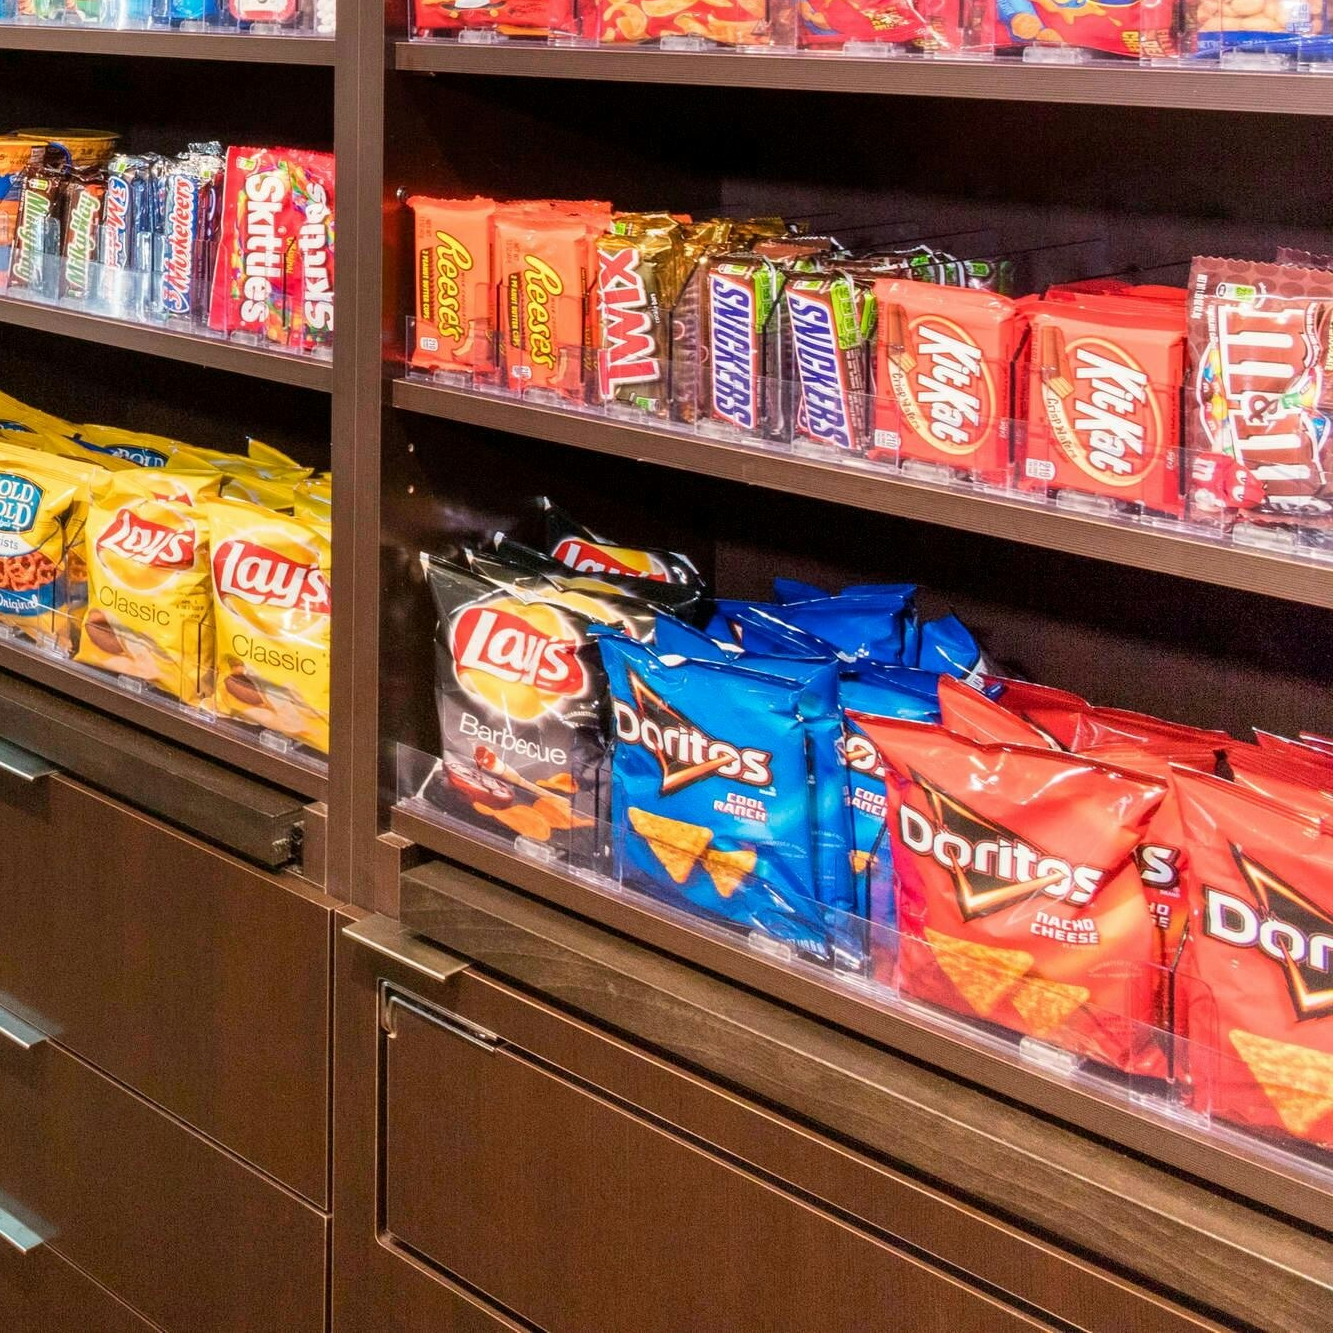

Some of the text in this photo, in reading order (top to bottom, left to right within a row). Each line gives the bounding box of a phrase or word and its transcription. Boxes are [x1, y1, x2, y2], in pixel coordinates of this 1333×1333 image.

[111, 180, 126, 200] 3
[66, 190, 100, 287] Milky Way
[164, 176, 195, 311] 3 Musketeers
[241, 174, 285, 323] Skittles
[298, 183, 335, 331] Skittles
[422, 280, 430, 301] BUTTER
[422, 304, 430, 319] CUPS
[436, 230, 474, 343] Reese's
[523, 254, 564, 371] Reese's
[511, 281, 520, 347] PEANUT BUTTER CUPS
[597, 248, 660, 400] TWIX
[712, 275, 753, 429] SNICKERS
[787, 288, 853, 450] SNICKERS
[891, 372, 907, 398] Crisp
[1047, 397, 1064, 426] Crisp
[886, 432, 896, 449] 210
[1041, 461, 1052, 479] 210
[104, 511, 194, 565] Lay's
[222, 542, 330, 613] Lay's
[99, 585, 171, 627] Classic
[233, 634, 317, 677] Classic
[460, 611, 571, 686] Lay's
[458, 711, 567, 766] Barbecue
[614, 700, 773, 787] Doritos
[713, 801, 768, 823] RANCH
[727, 792, 764, 808] COOL
[855, 786, 888, 806] COO
[900, 804, 1104, 906] Doritos
[1030, 921, 1099, 945] CHEESE
[1036, 911, 1095, 932] NACHO
